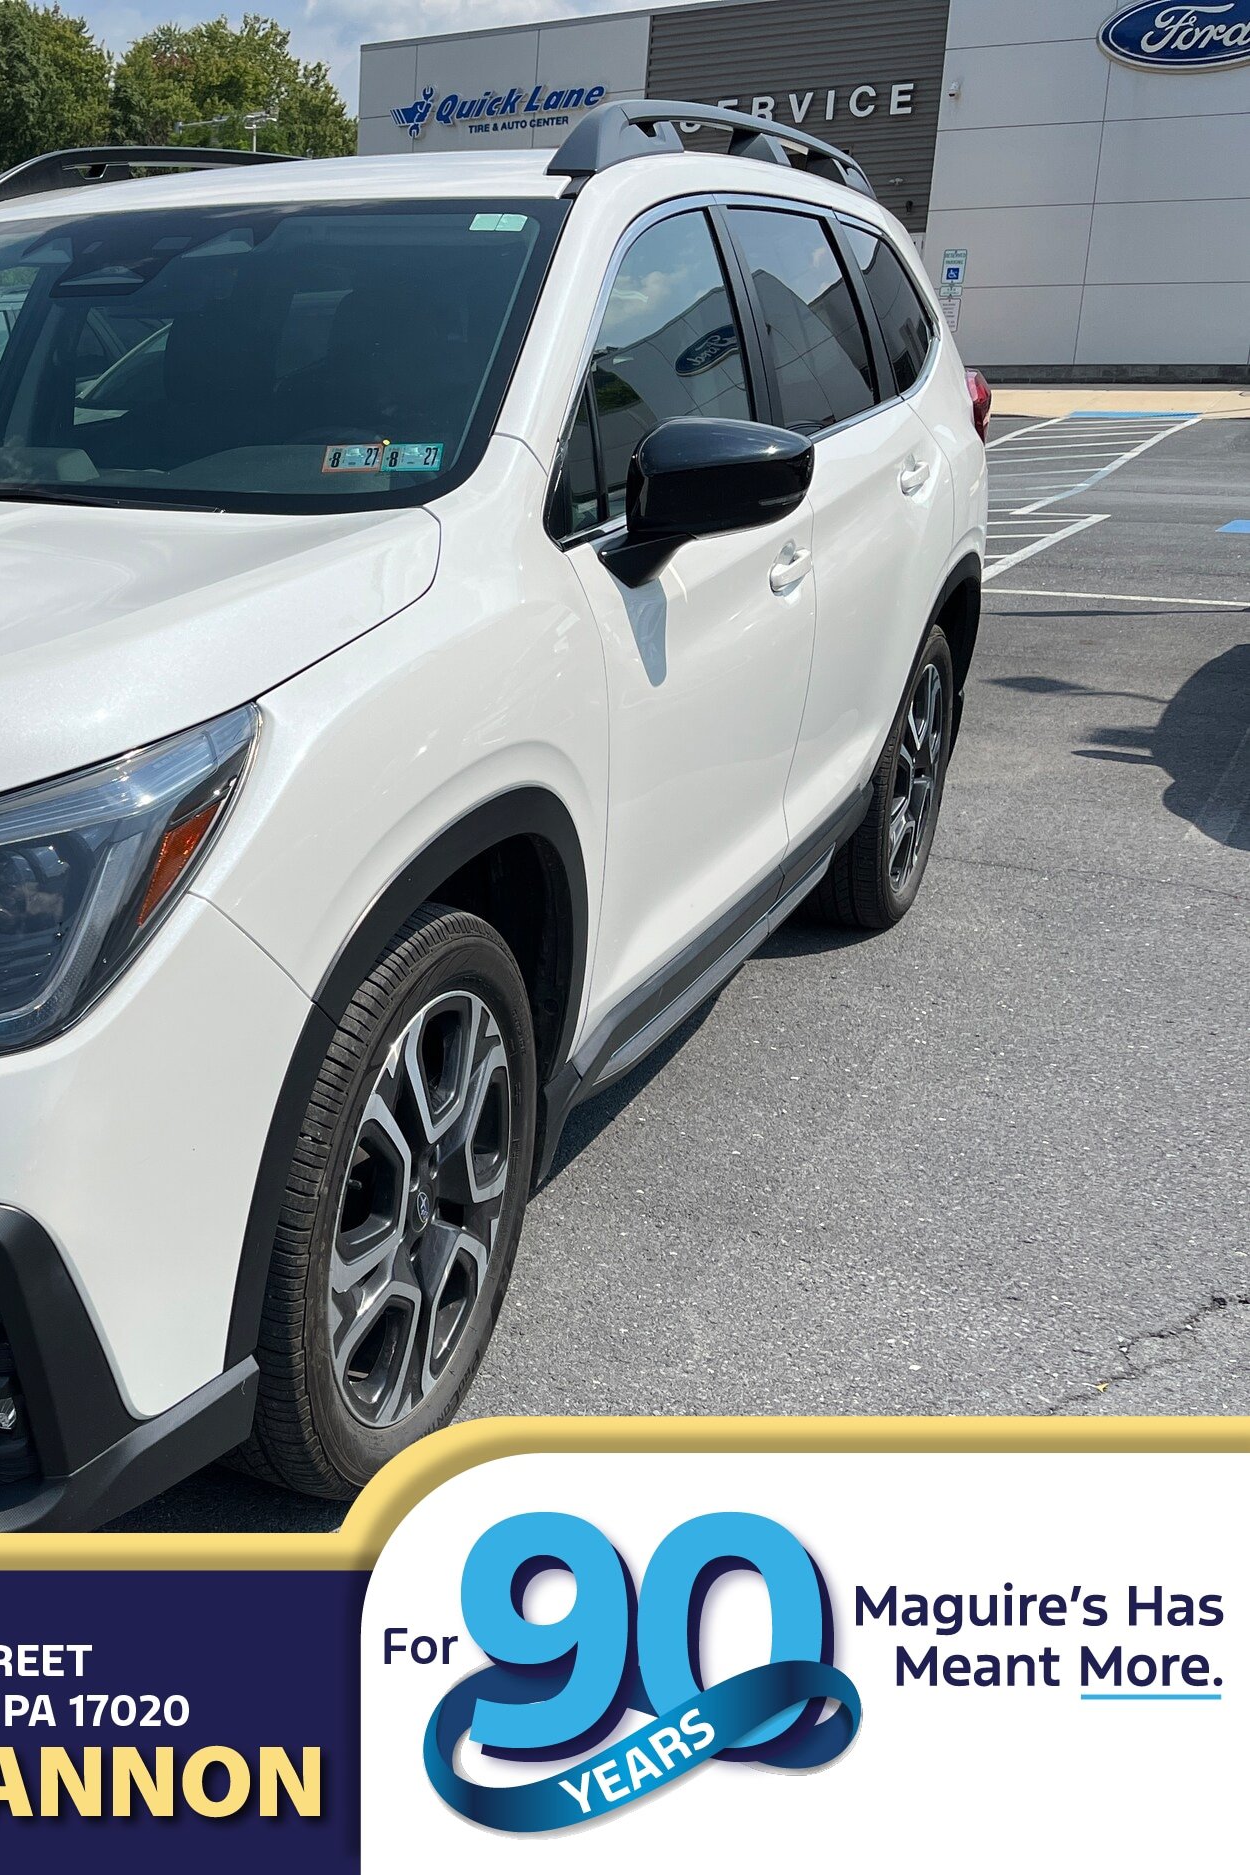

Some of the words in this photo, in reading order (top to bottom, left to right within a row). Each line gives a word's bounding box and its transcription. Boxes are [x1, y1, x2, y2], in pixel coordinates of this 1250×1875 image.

[435, 87, 523, 125] Quick
[523, 85, 606, 112] Lane
[679, 83, 914, 133] RVICE
[468, 123, 490, 134] TIRE
[491, 123, 500, 132] &
[500, 119, 528, 131] AUTO
[529, 116, 569, 129] CENTER
[330, 451, 342, 468] 8
[364, 447, 380, 466] 27
[388, 451, 399, 468] 8
[423, 447, 439, 466] 27
